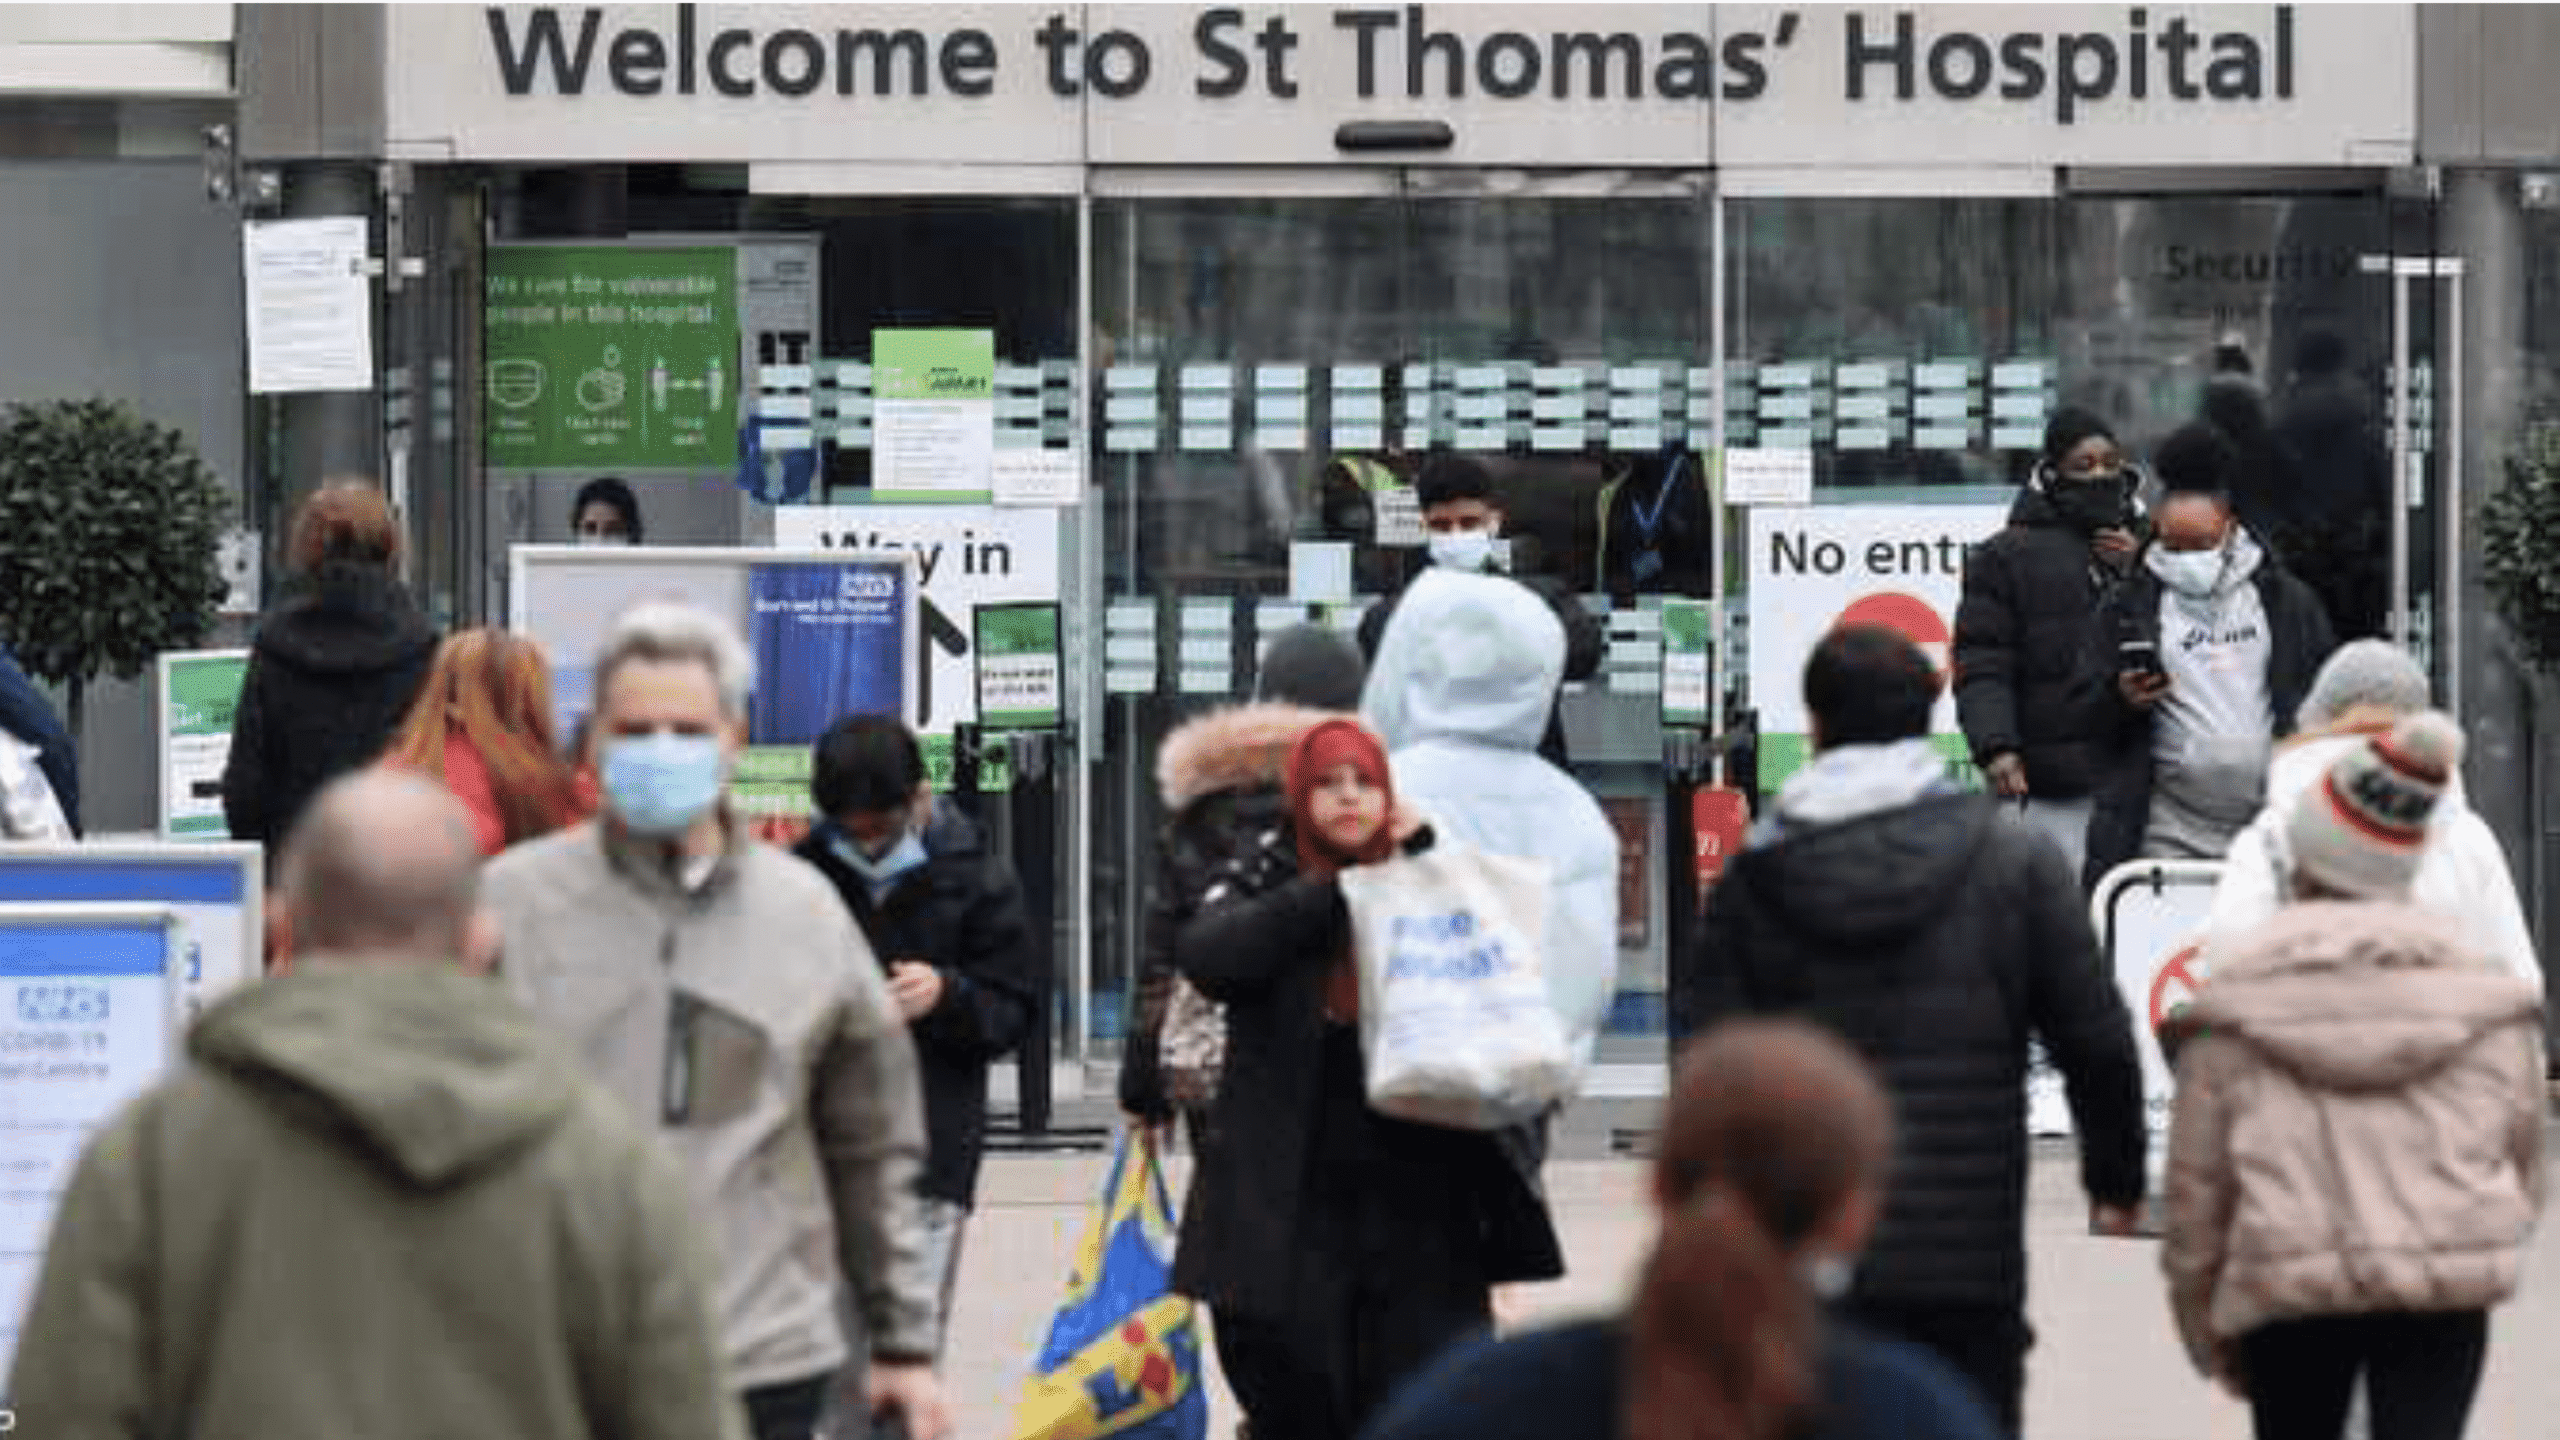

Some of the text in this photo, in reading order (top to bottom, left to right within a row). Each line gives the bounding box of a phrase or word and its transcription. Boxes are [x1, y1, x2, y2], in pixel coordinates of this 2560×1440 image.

[486, 3, 998, 98] Welcome
[1035, 15, 1152, 99] to
[1194, 8, 1299, 100] St
[1844, 5, 2295, 125] Hospital
[2166, 245, 2355, 286] Security
[964, 530, 1010, 575] in
[1770, 531, 1982, 575] No entr
